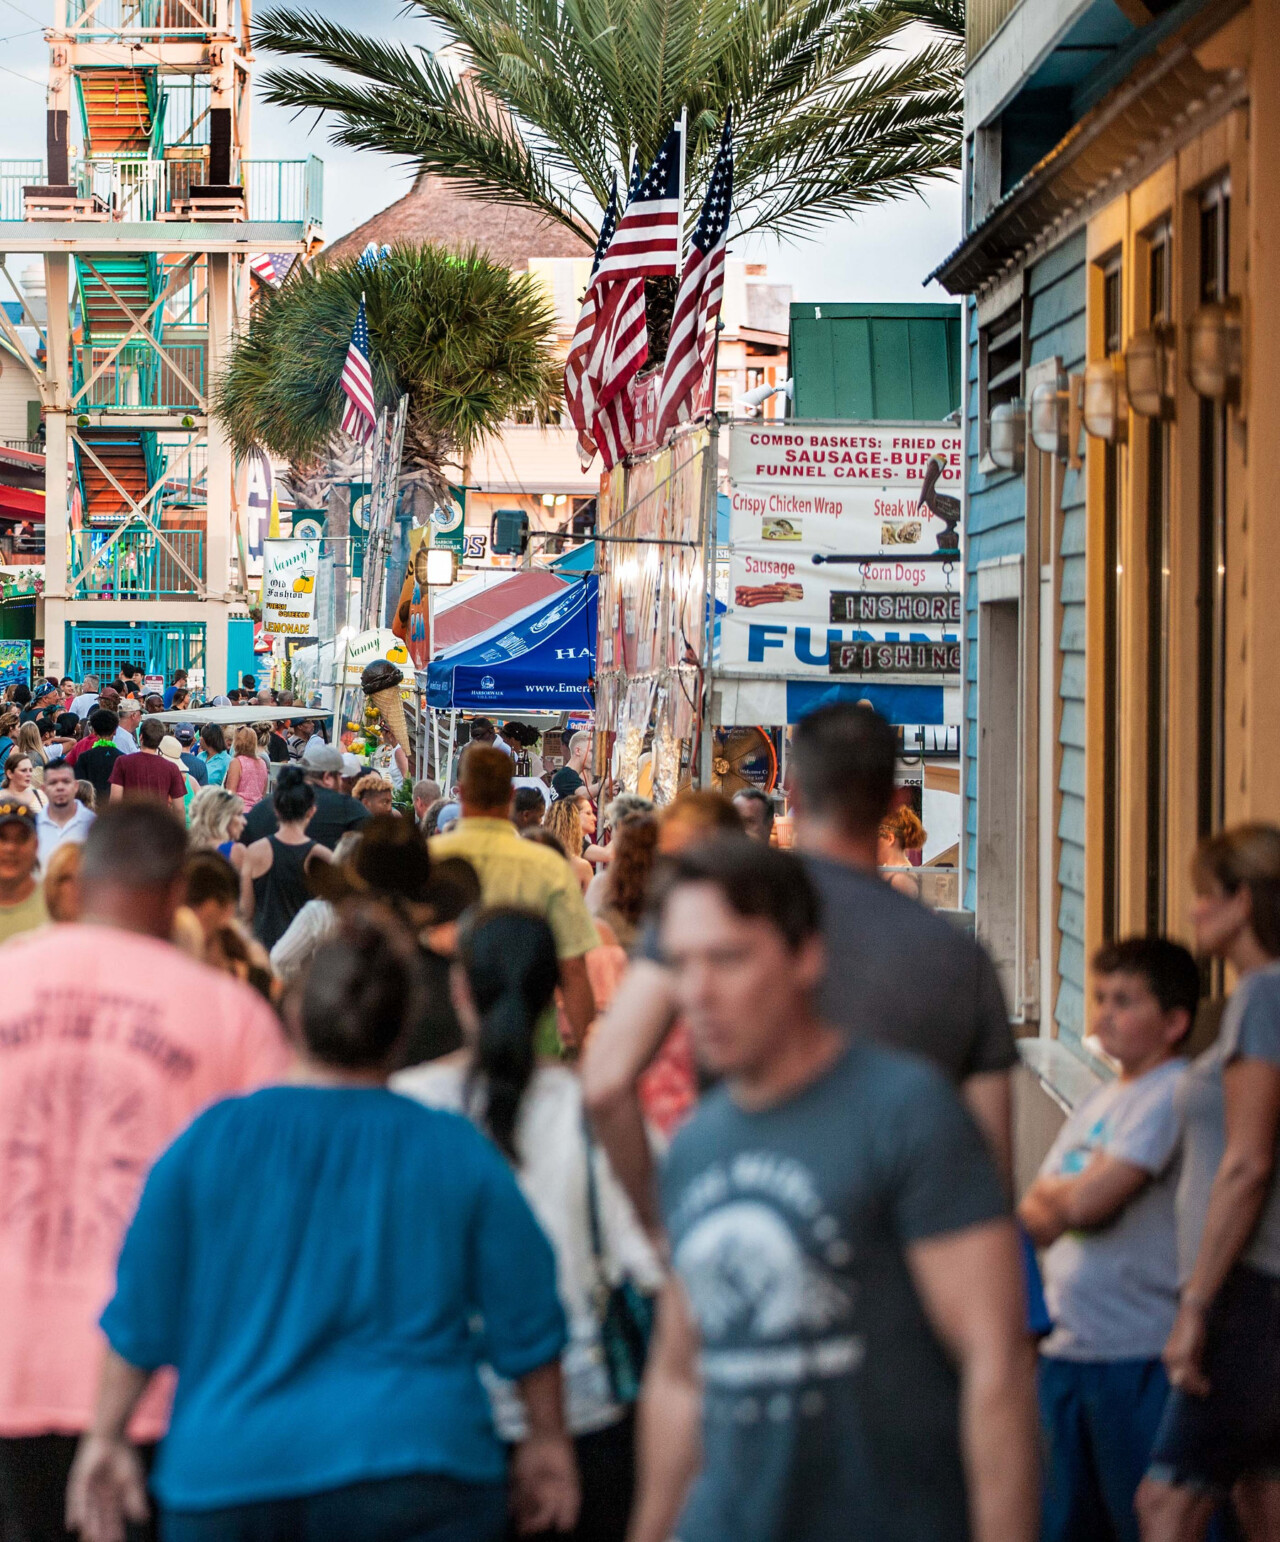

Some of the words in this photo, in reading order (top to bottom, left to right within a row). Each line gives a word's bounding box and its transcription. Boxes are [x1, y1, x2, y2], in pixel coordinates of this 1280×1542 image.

[750, 434, 805, 447] COMBO
[810, 436, 882, 449] BASKETS:
[892, 438, 936, 449] FRIED
[756, 464, 826, 477] FUNNEL
[833, 466, 899, 479] CAKES-
[732, 493, 767, 517] Crispy
[769, 494, 812, 513] Chicken
[814, 497, 843, 518] Wrap
[874, 498, 904, 517] Steak
[906, 500, 935, 521] Wrap
[268, 542, 314, 574] Nanny's
[745, 557, 795, 577] Sausage
[863, 563, 892, 581] Corn
[895, 564, 926, 586] Dogs
[270, 579, 287, 588] Old
[266, 602, 287, 611] FRESH
[846, 596, 960, 619] INSHORE
[264, 620, 310, 635] LEMONADE
[840, 645, 960, 668] FISHING
